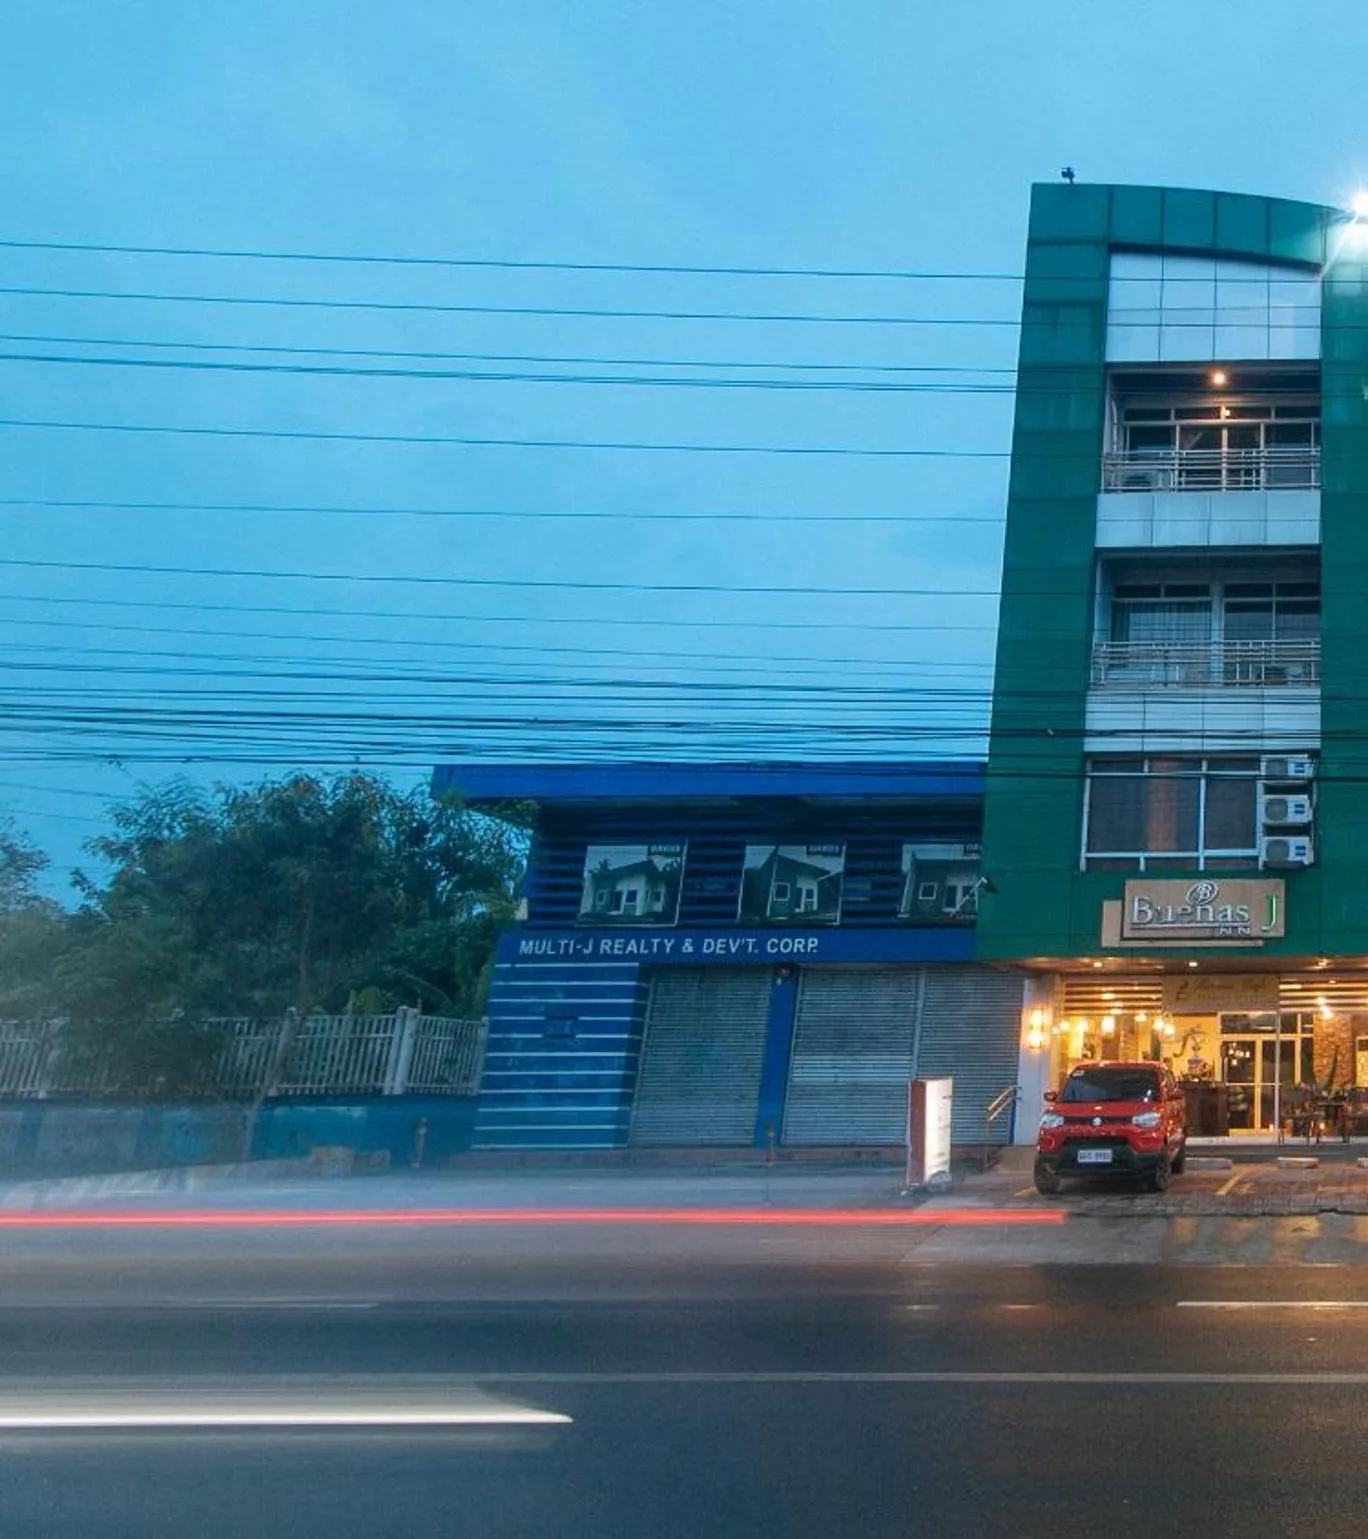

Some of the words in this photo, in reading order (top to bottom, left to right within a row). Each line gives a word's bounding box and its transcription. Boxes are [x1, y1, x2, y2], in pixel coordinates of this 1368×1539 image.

[1261, 893, 1278, 932] J
[519, 938, 594, 955] MULTI-J
[599, 938, 675, 955] REALTY
[681, 938, 694, 953] &
